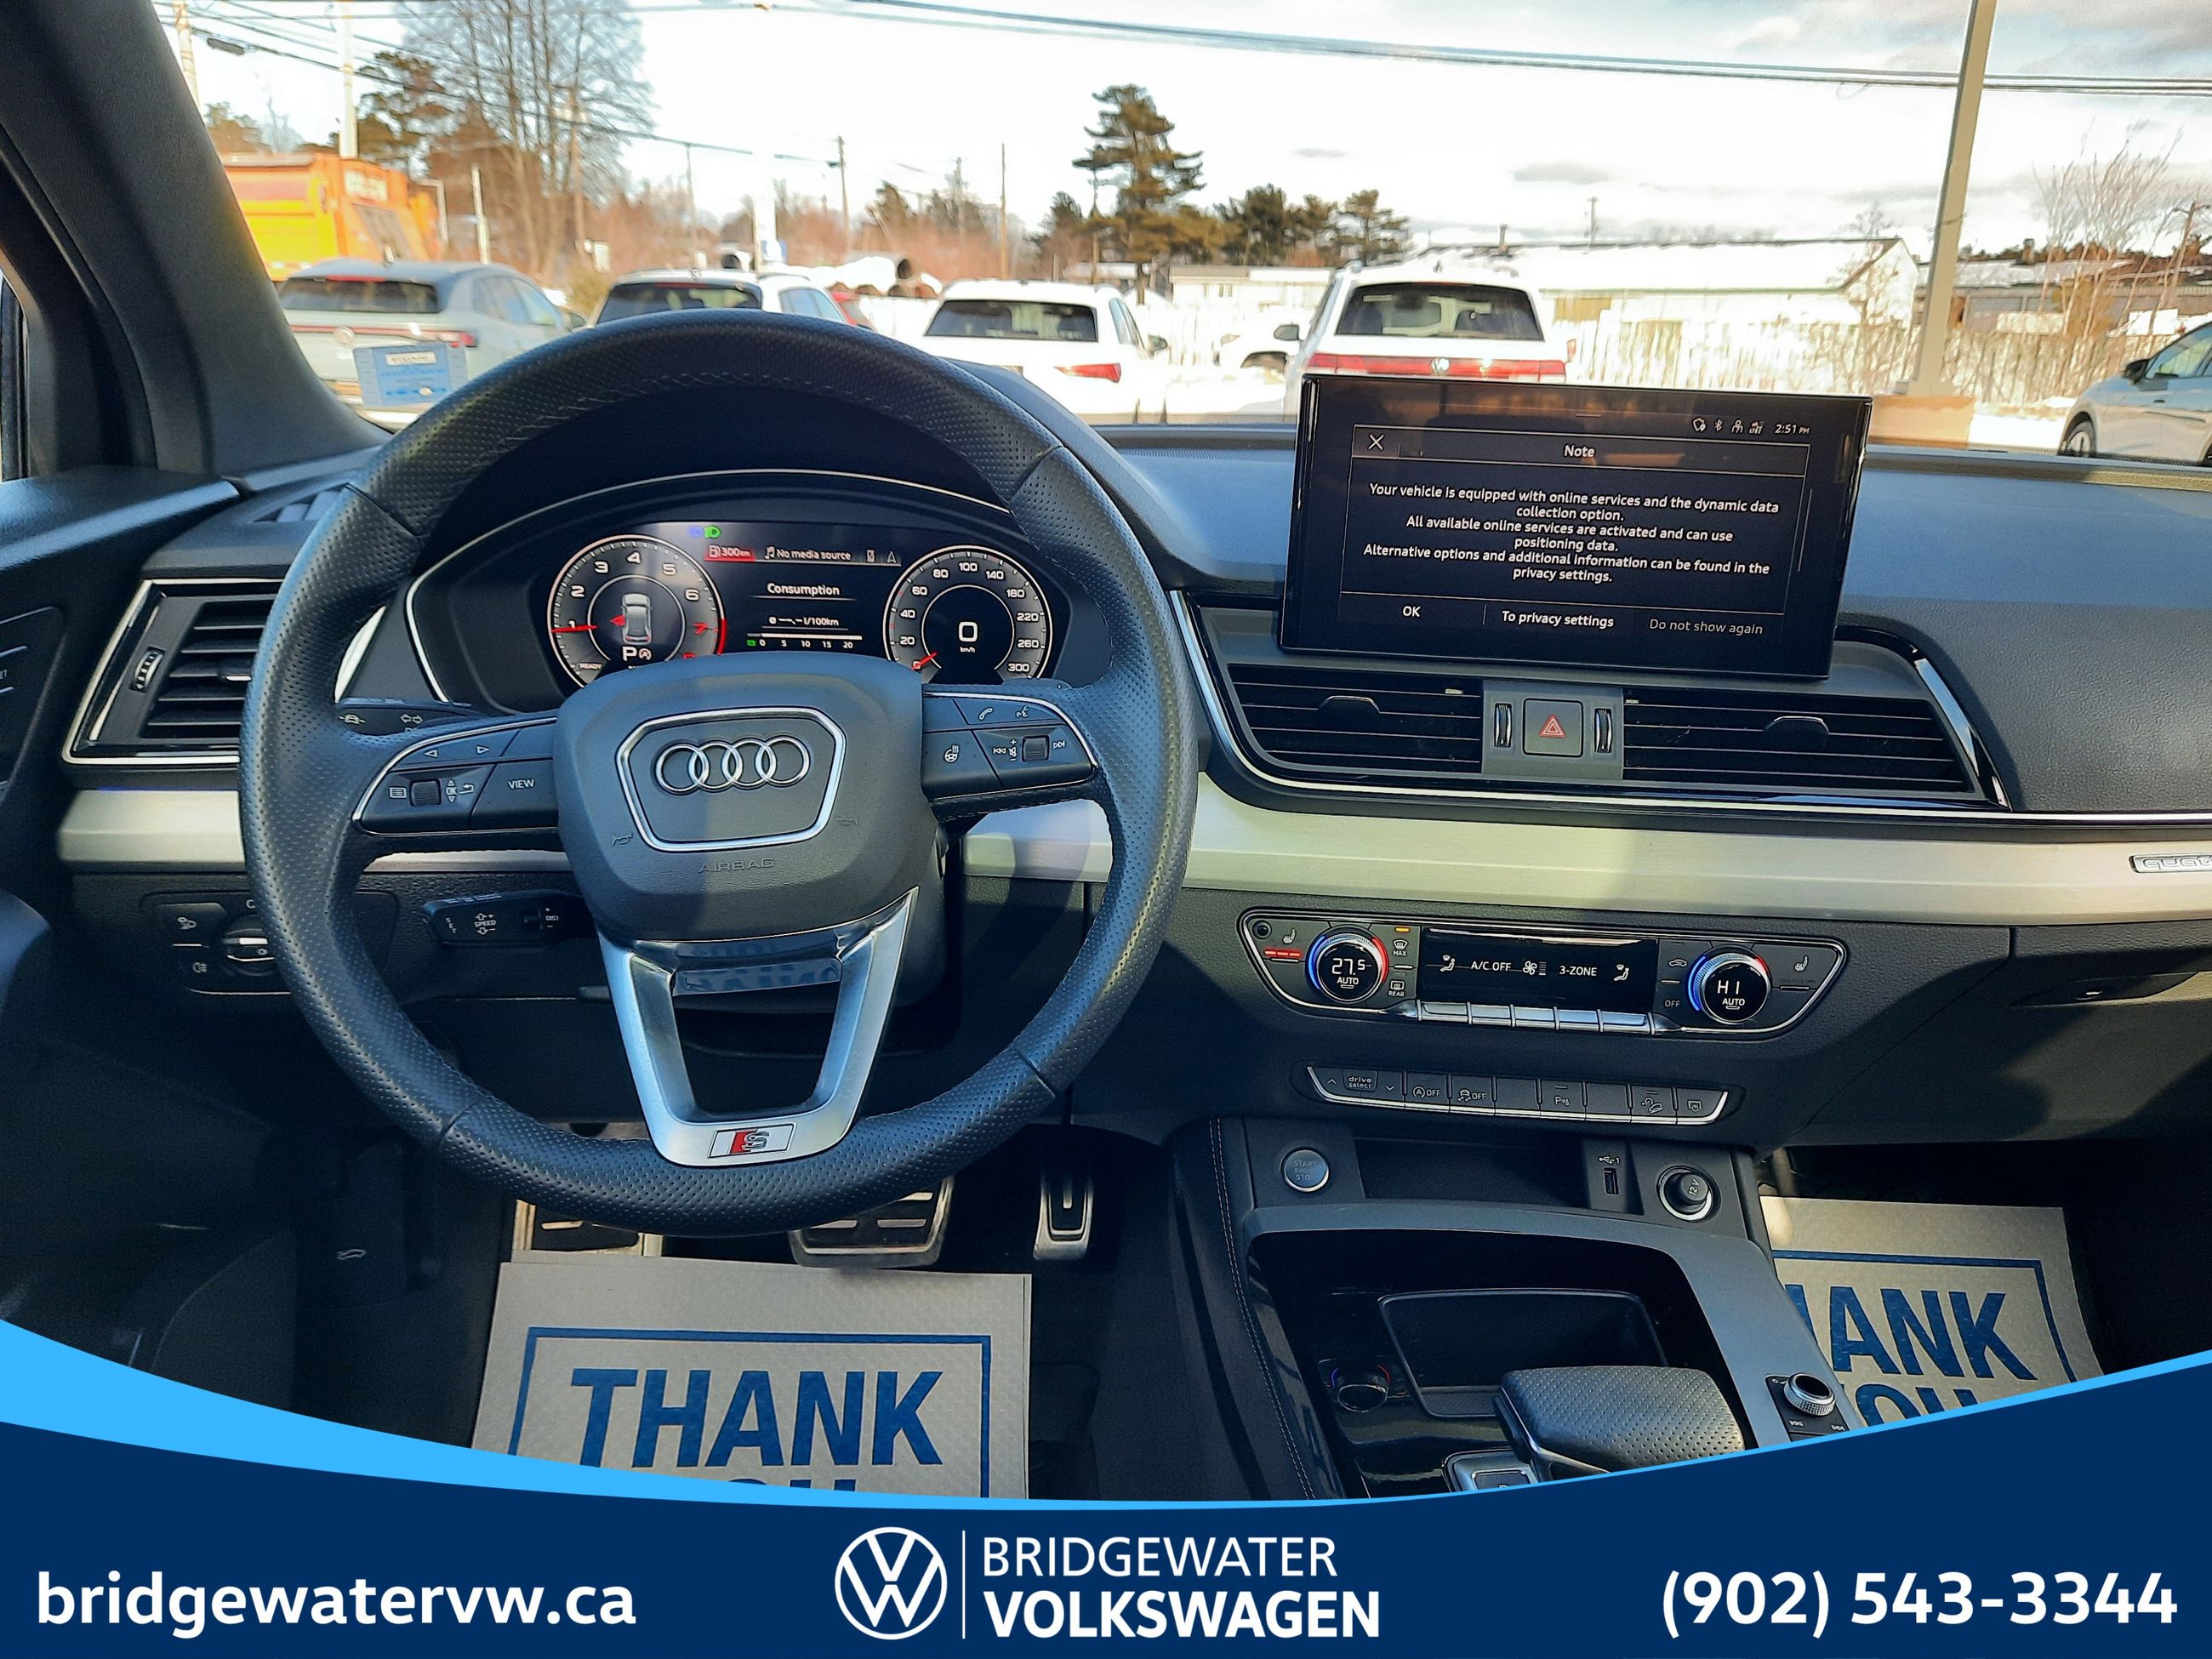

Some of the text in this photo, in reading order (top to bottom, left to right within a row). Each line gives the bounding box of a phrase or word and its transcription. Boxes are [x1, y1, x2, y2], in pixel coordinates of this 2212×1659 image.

[1775, 424, 1797, 435] 2:51
[1564, 444, 1595, 458] Note
[1369, 482, 1779, 514] Your vehicle is equipped with online services and the dynamic data
[1516, 506, 1624, 522] collection option.
[1405, 515, 1734, 542] All available online services are activated and can use
[1514, 537, 1618, 552] positioning data.
[626, 551, 641, 564] 4
[776, 549, 852, 561] No media source
[1363, 544, 1770, 574] Alternative options and additional information can be found in the
[594, 561, 609, 573] 3
[662, 563, 676, 575] 5
[958, 562, 978, 572] 100
[932, 568, 949, 579] 80
[985, 570, 1004, 580] 140
[1513, 567, 1613, 584] privacy settings.
[570, 584, 585, 597] 2
[684, 589, 700, 601] 6
[767, 582, 841, 596] Consumption
[911, 586, 928, 596] 60
[1006, 589, 1025, 598] 180
[899, 609, 915, 619] 40
[1016, 613, 1040, 622] 220
[1402, 605, 1421, 618] OK
[1502, 610, 1615, 630] To privacy settings
[693, 622, 709, 635] 7
[958, 621, 978, 642] 0
[1649, 619, 1764, 636] Do not show again
[899, 636, 915, 645] 20
[1017, 639, 1040, 648] 260
[622, 646, 637, 661] P
[1007, 663, 1030, 672] 300
[507, 778, 534, 790] VIEW
[446, 786, 458, 795] OK
[698, 857, 775, 874] AIRBAG
[473, 919, 497, 928] SPEED
[1470, 961, 1512, 972] A/C OFF
[1559, 965, 1598, 977] 3-ZONE
[1722, 997, 1746, 1006] AUTO
[570, 1368, 944, 1469] THANK
